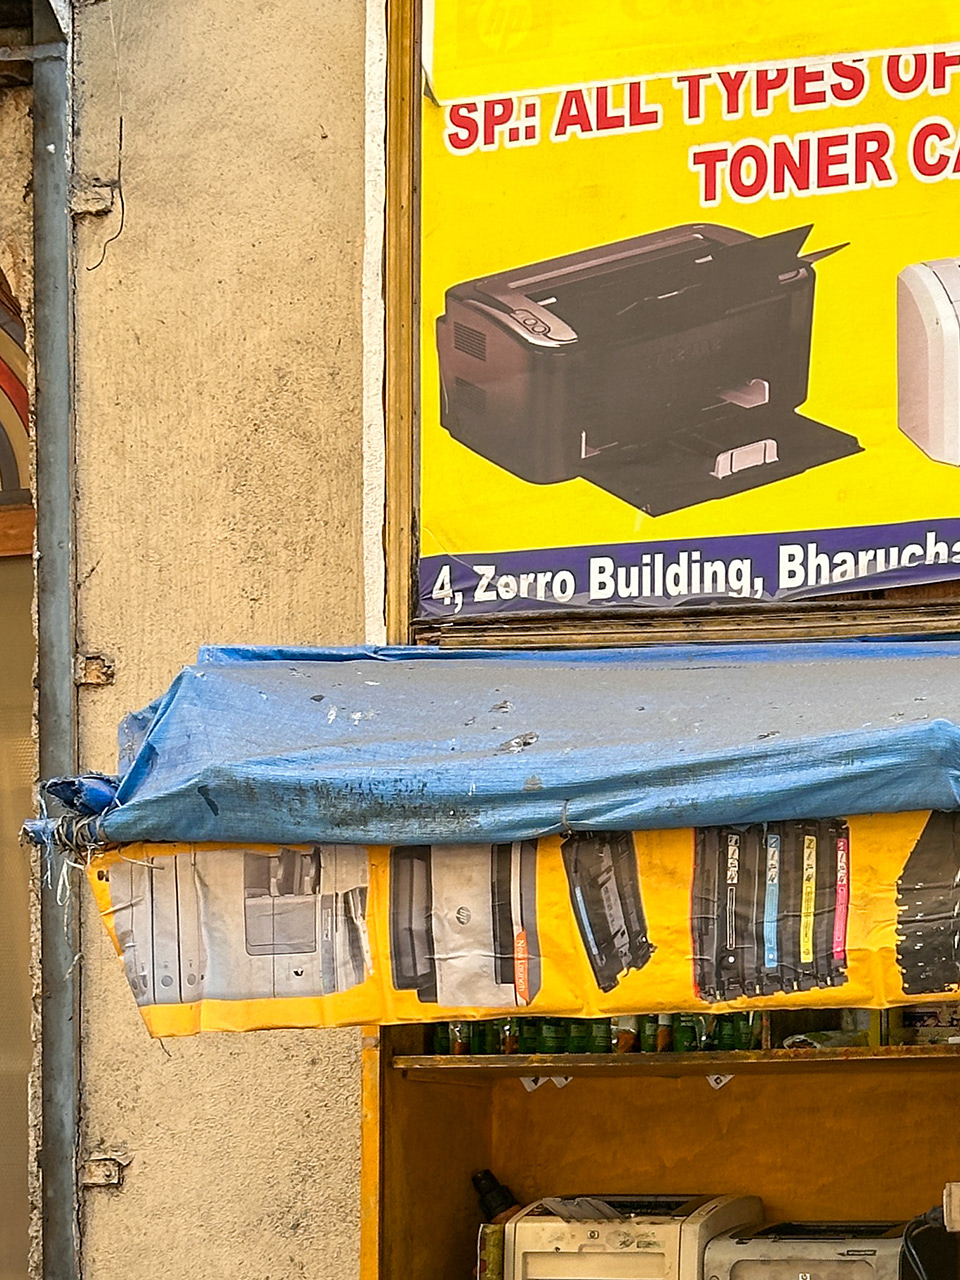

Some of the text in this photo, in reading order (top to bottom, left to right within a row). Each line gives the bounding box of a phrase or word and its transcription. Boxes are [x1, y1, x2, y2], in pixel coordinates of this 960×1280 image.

[555, 82, 658, 136] ALL
[677, 59, 866, 119] TYPES
[886, 51, 960, 94] OF
[693, 130, 892, 201] TONER
[432, 565, 463, 613] 4,
[589, 551, 764, 599] Building,
